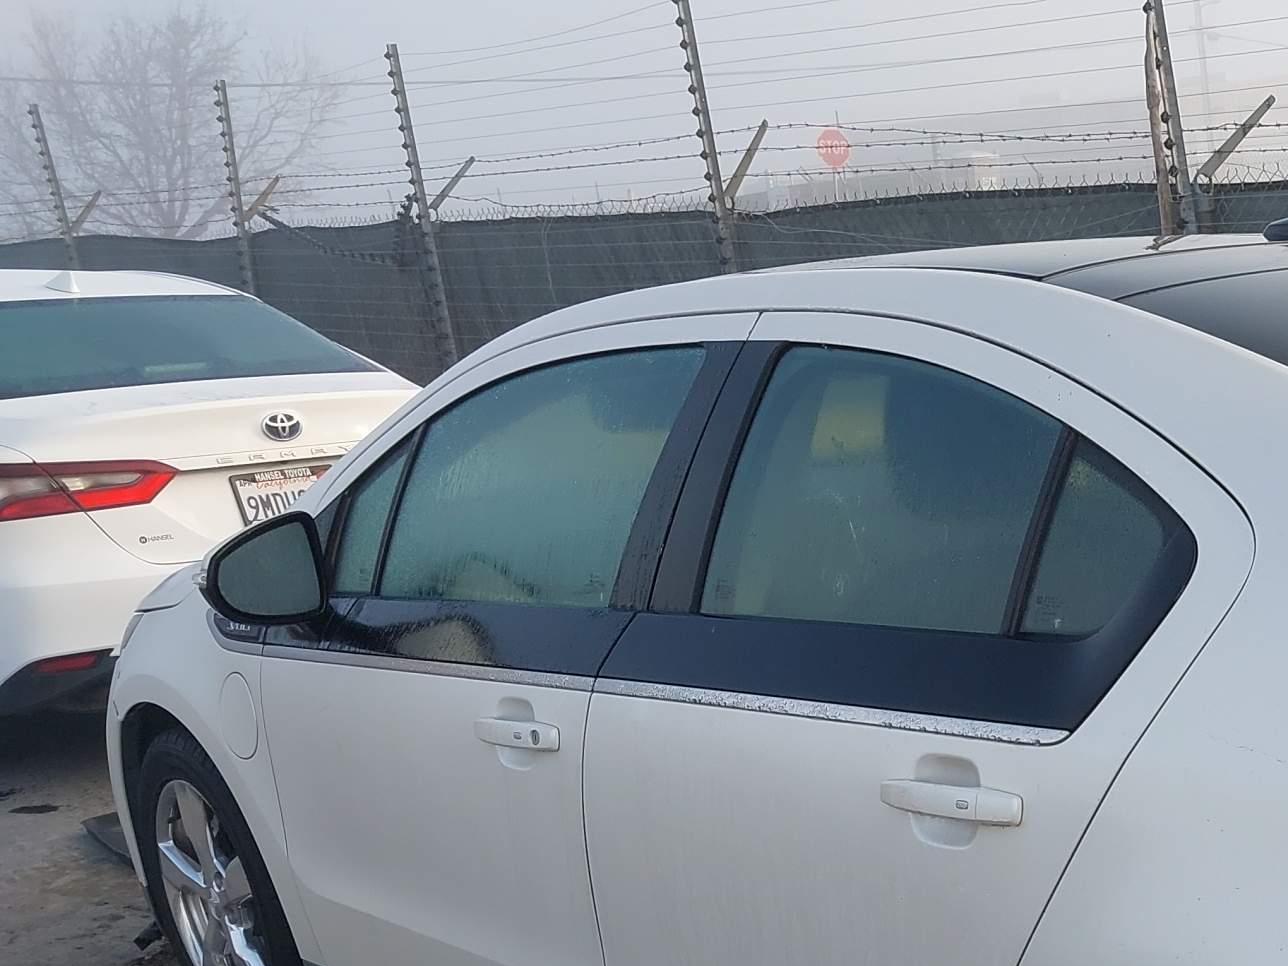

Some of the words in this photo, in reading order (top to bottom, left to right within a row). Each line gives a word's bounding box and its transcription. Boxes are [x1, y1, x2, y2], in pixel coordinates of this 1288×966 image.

[819, 140, 847, 155] STOP
[254, 470, 284, 481] HANSEL
[285, 468, 312, 478] TOYOTA
